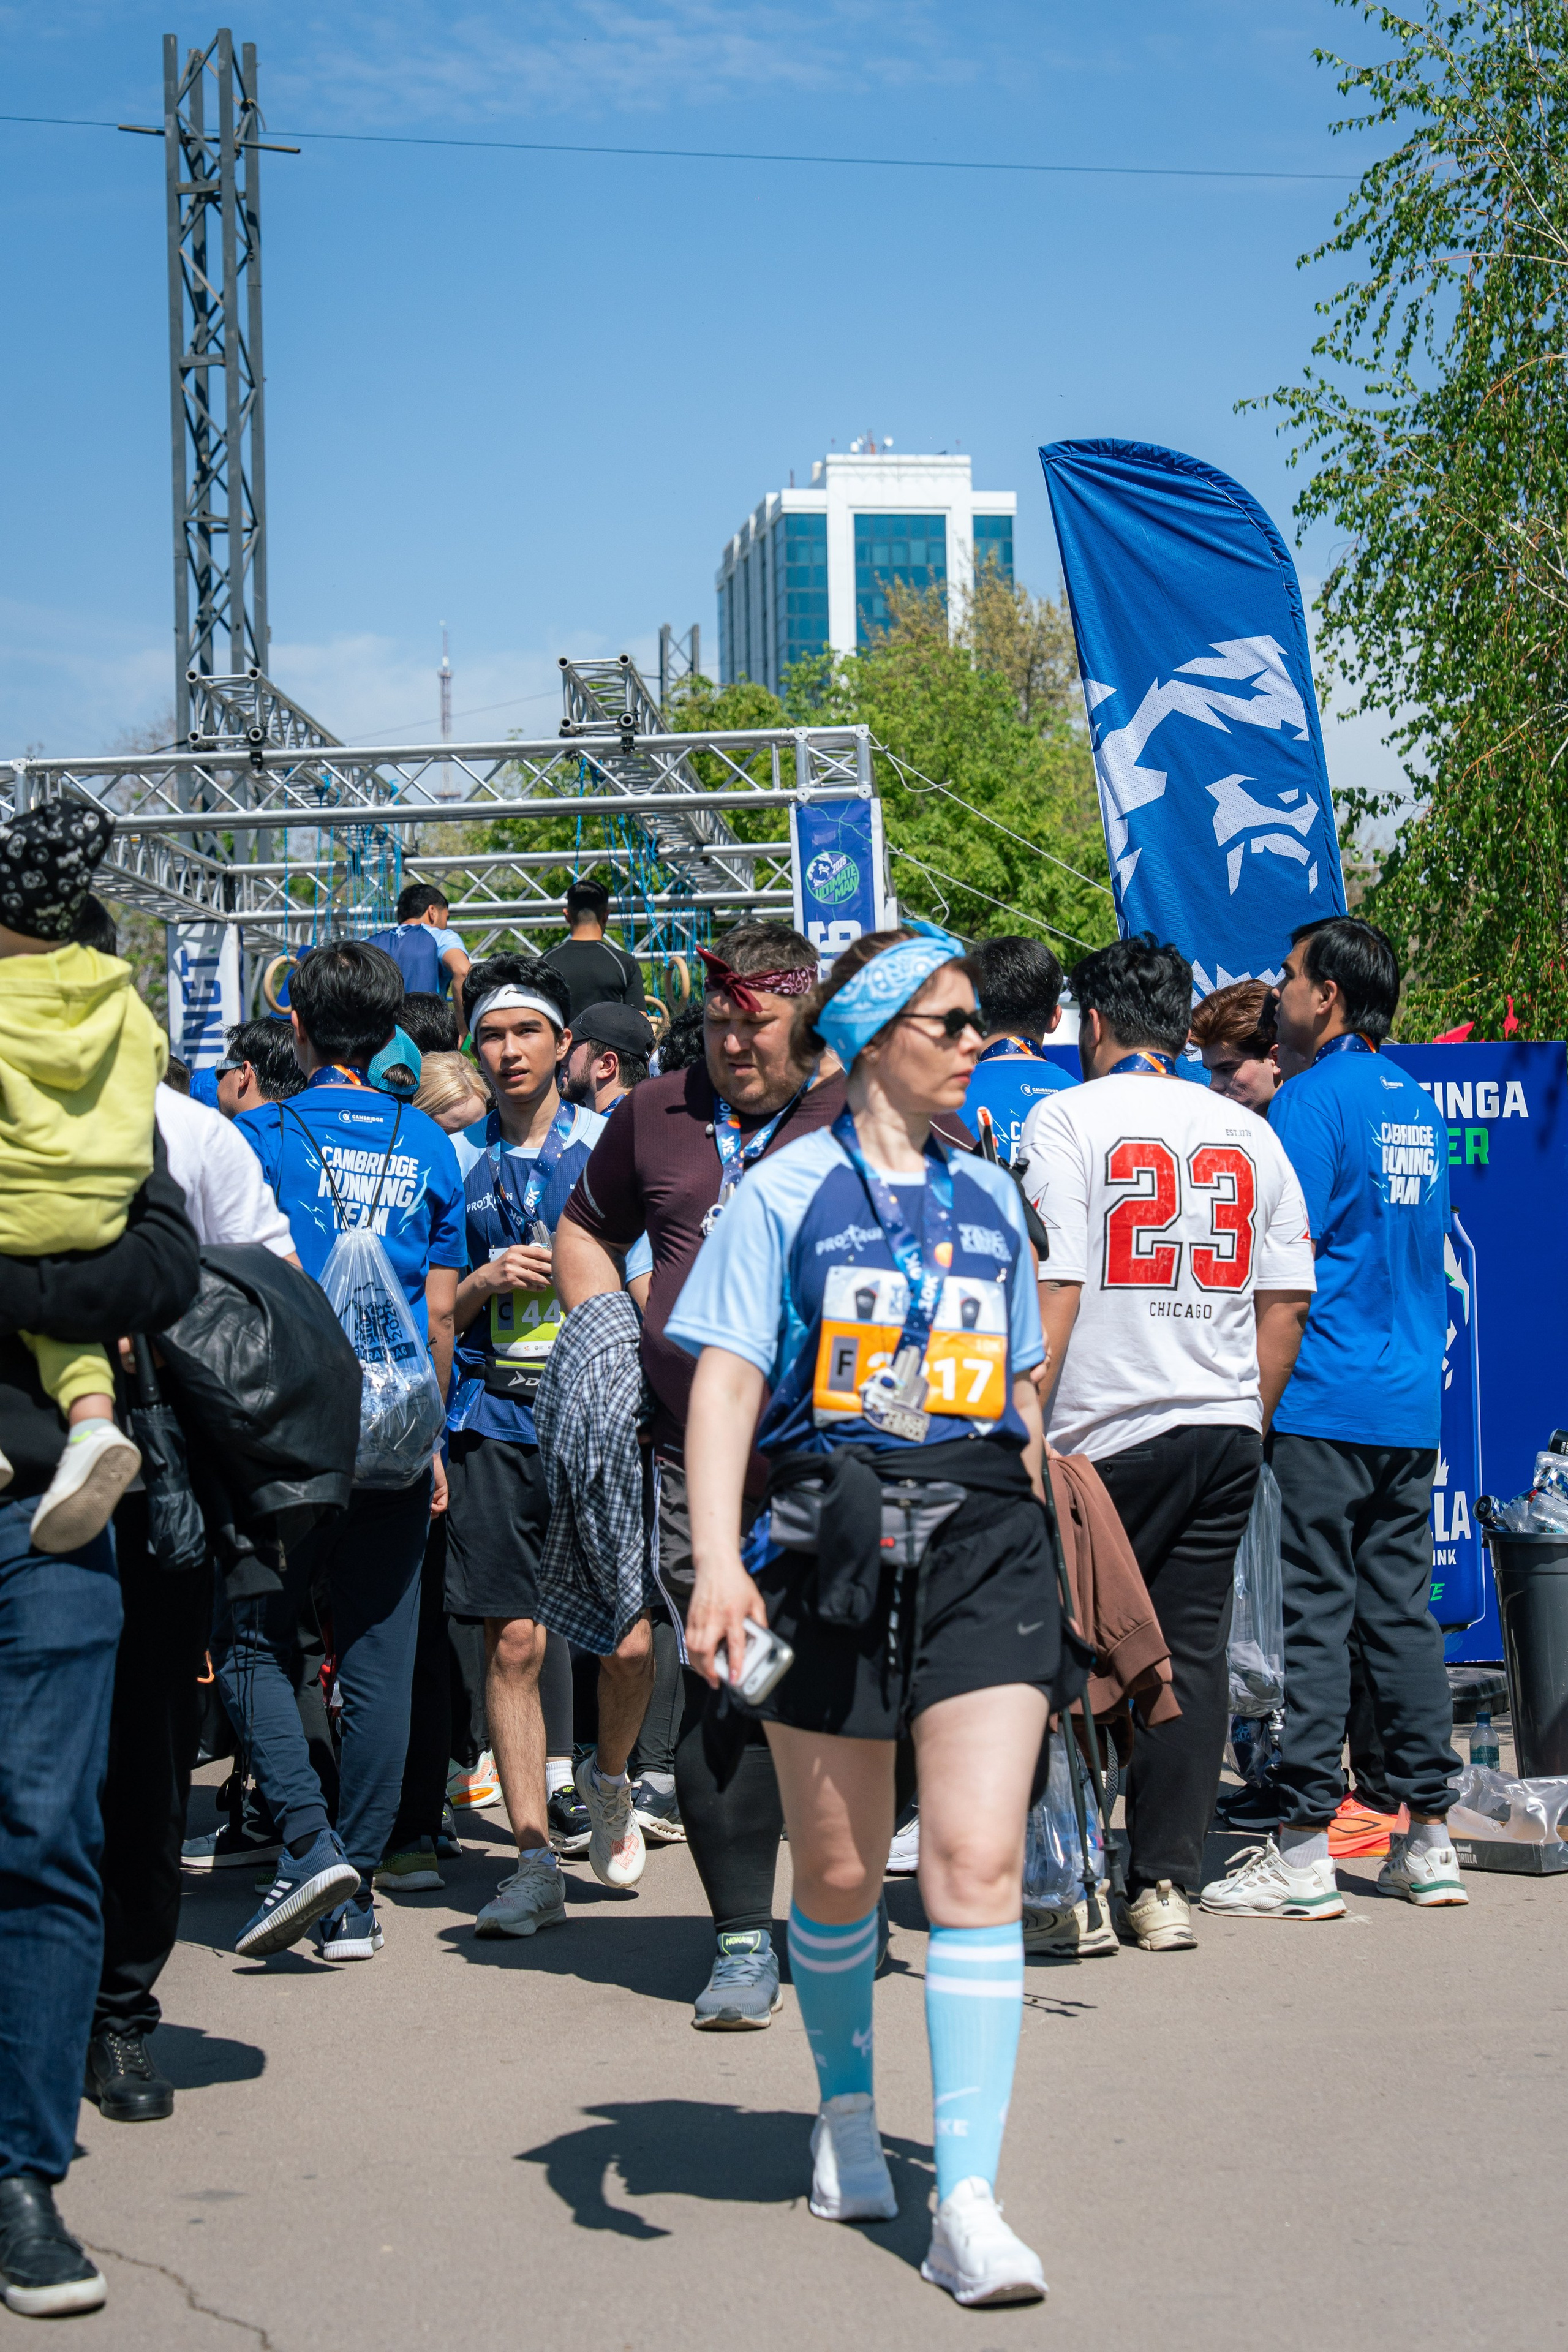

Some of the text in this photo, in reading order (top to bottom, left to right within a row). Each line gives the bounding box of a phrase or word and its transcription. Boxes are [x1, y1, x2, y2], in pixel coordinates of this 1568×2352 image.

[832, 855, 848, 874] 2026
[815, 864, 857, 900] ULTIMATE
[834, 876, 858, 902] MAN
[1418, 1081, 1529, 1119] INGA
[352, 1114, 383, 1123] CAMBRIDGE
[721, 1135, 735, 1156] 3K
[321, 1146, 419, 1178] CAMBRIDGE
[318, 1168, 417, 1208] RUNNING
[526, 1188, 540, 1208] 5K
[331, 1200, 390, 1236] TEAM
[467, 1200, 483, 1213] PRO
[1100, 1137, 1257, 1294] 23
[499, 1302, 511, 1321] C
[1150, 1302, 1212, 1319] CHICAGO
[838, 1349, 854, 1376] F
[1431, 1491, 1471, 1542] LA
[726, 1936, 745, 1946] HOKA
